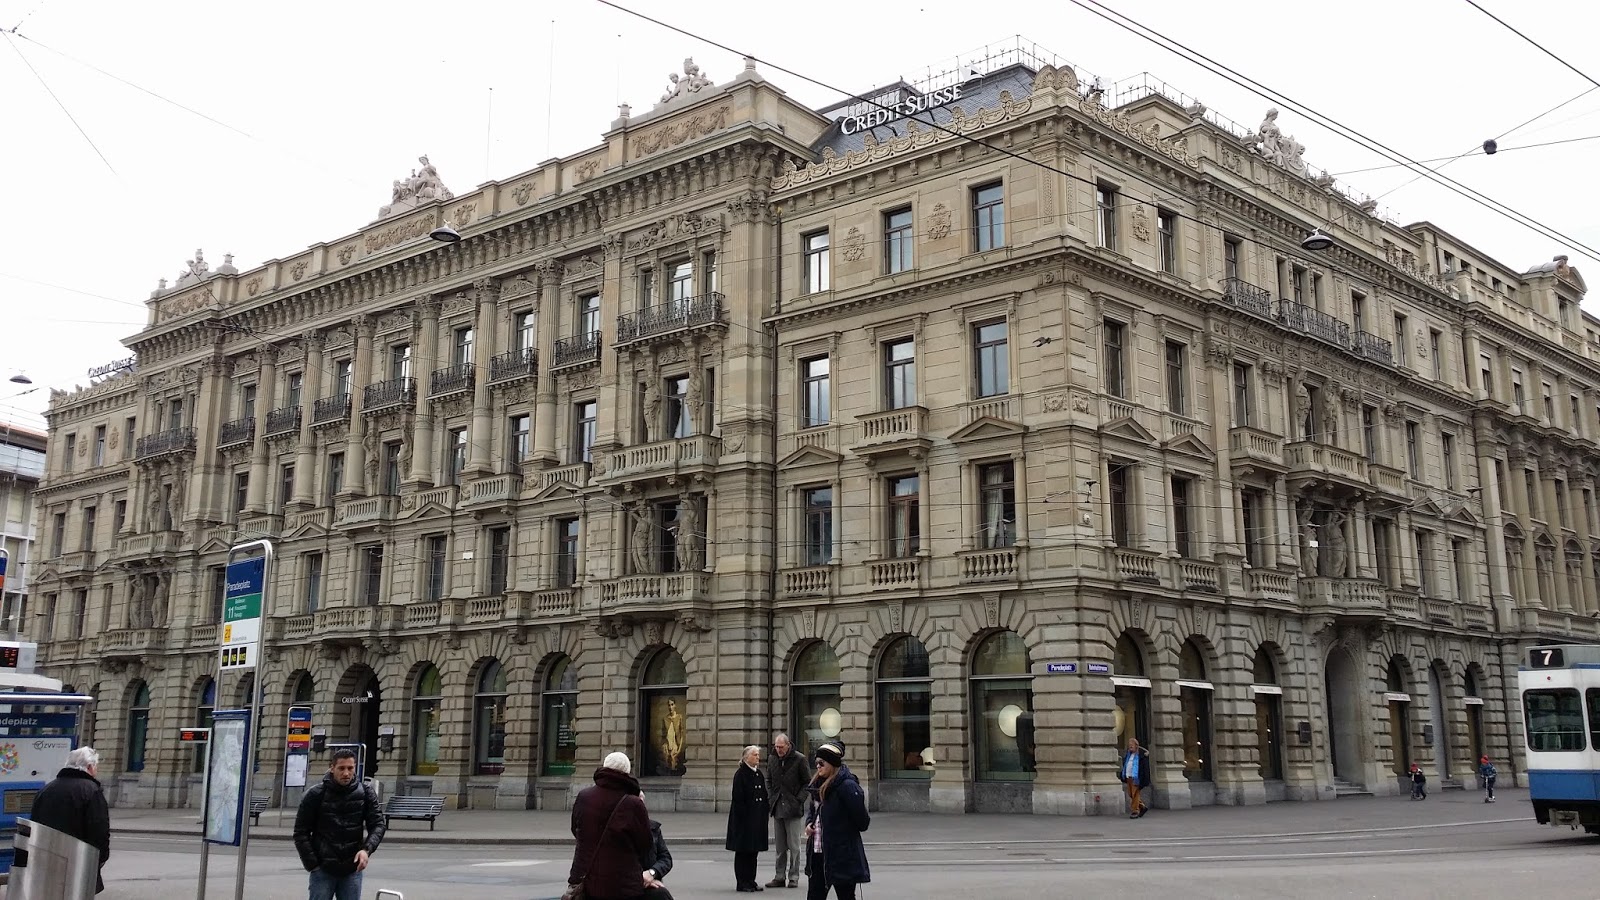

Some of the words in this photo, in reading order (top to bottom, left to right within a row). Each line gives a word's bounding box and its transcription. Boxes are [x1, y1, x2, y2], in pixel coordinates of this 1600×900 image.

[841, 103, 904, 135] CREDIT
[905, 83, 962, 115] SUISSE
[226, 580, 251, 592] Paradeplatz
[228, 607, 234, 618] 11
[1540, 650, 1553, 666] 7
